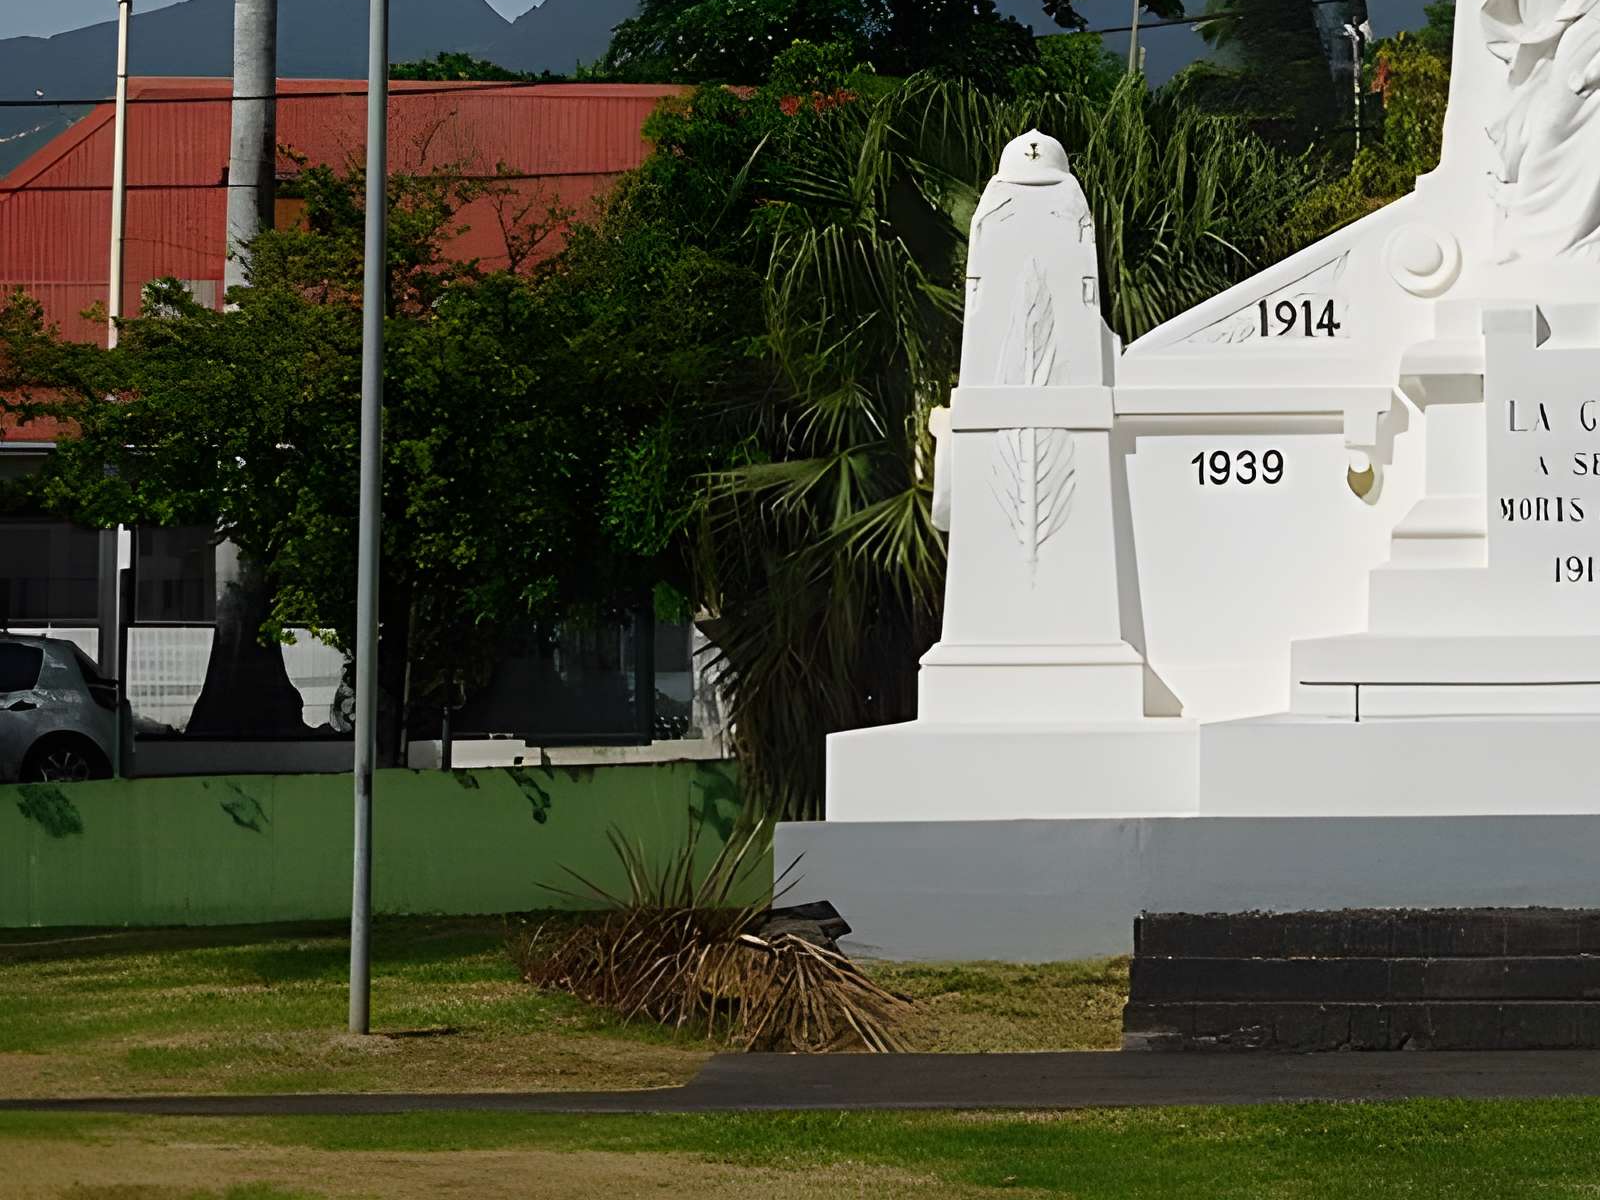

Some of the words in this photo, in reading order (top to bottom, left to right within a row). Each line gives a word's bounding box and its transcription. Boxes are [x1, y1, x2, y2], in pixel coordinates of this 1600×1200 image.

[1258, 299, 1341, 337] 1914
[1509, 400, 1550, 432] LA
[1191, 449, 1284, 485] 1939
